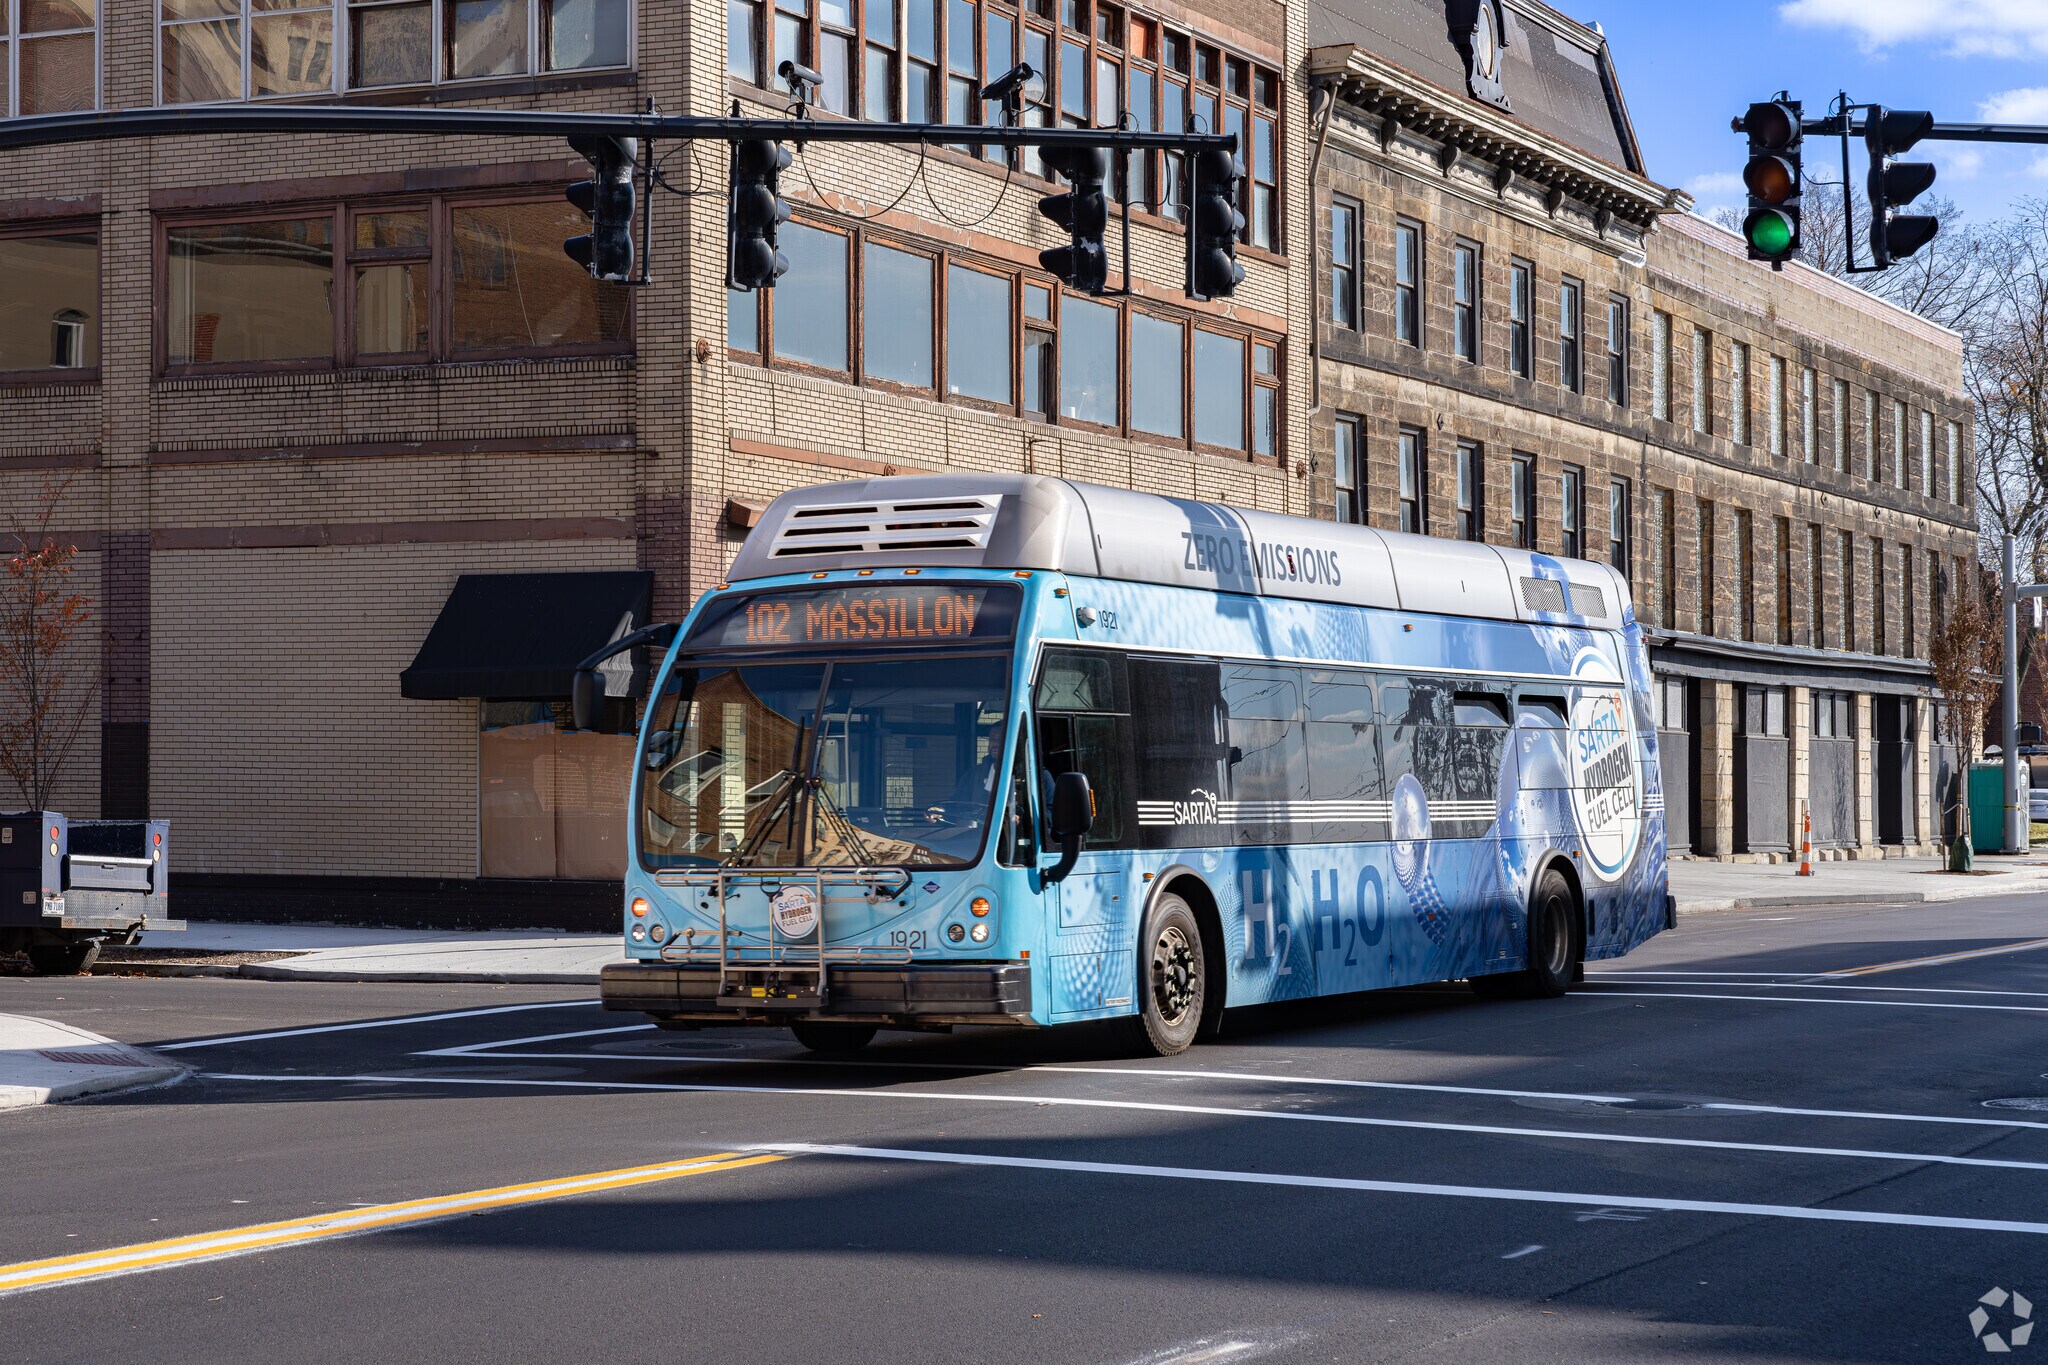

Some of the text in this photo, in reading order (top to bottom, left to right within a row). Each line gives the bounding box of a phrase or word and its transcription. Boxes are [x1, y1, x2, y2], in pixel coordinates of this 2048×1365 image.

[1181, 532, 1341, 587] ZERO EMISSIONS
[745, 594, 975, 643] 102 MASSILLON
[1098, 609, 1119, 630] 1921
[1583, 741, 1632, 805] HYDROGEN
[1587, 782, 1635, 833] FUEL CELL
[780, 905, 813, 921] HYDROGEN
[781, 914, 814, 927] FUEL CELL
[889, 929, 927, 950] 1921
